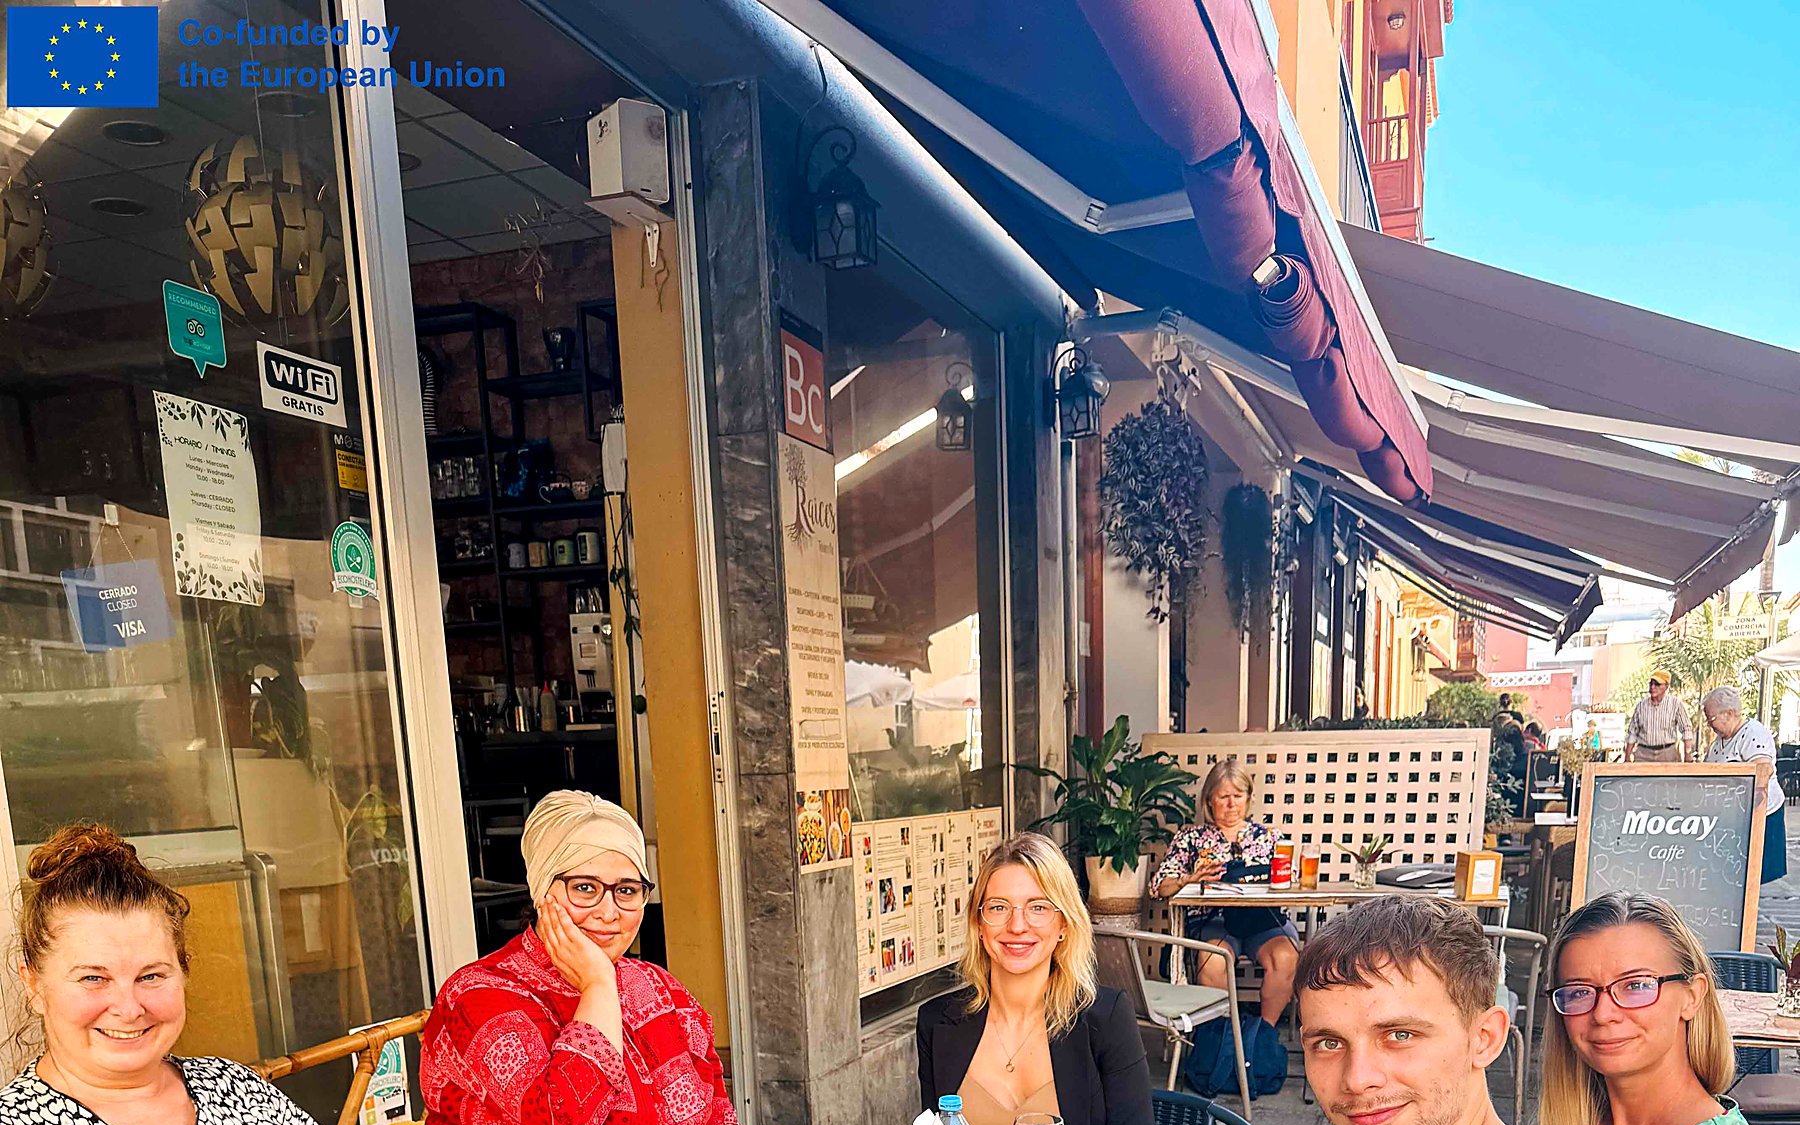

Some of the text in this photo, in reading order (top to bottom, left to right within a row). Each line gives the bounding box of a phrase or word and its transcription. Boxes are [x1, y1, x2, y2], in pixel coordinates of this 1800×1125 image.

[168, 292, 217, 315] RECOMMENDED
[270, 359, 332, 396] WiFi
[784, 343, 823, 435] Bc
[282, 396, 325, 416] GRATIS
[174, 436, 202, 449] HORARIO
[211, 444, 236, 458] TIMINGS
[189, 454, 203, 464] Lunes
[185, 463, 235, 480] Monday Wednesday
[208, 494, 234, 505] CERRADO
[215, 504, 236, 513] CLOSED
[99, 585, 138, 601] CERRADO
[107, 599, 138, 612] CLOSED
[113, 619, 147, 639] VISA
[1724, 623, 1767, 631] COMERCIAL
[1600, 781, 1746, 812] SPECIAL OFFER
[1621, 810, 1719, 841] Mocay
